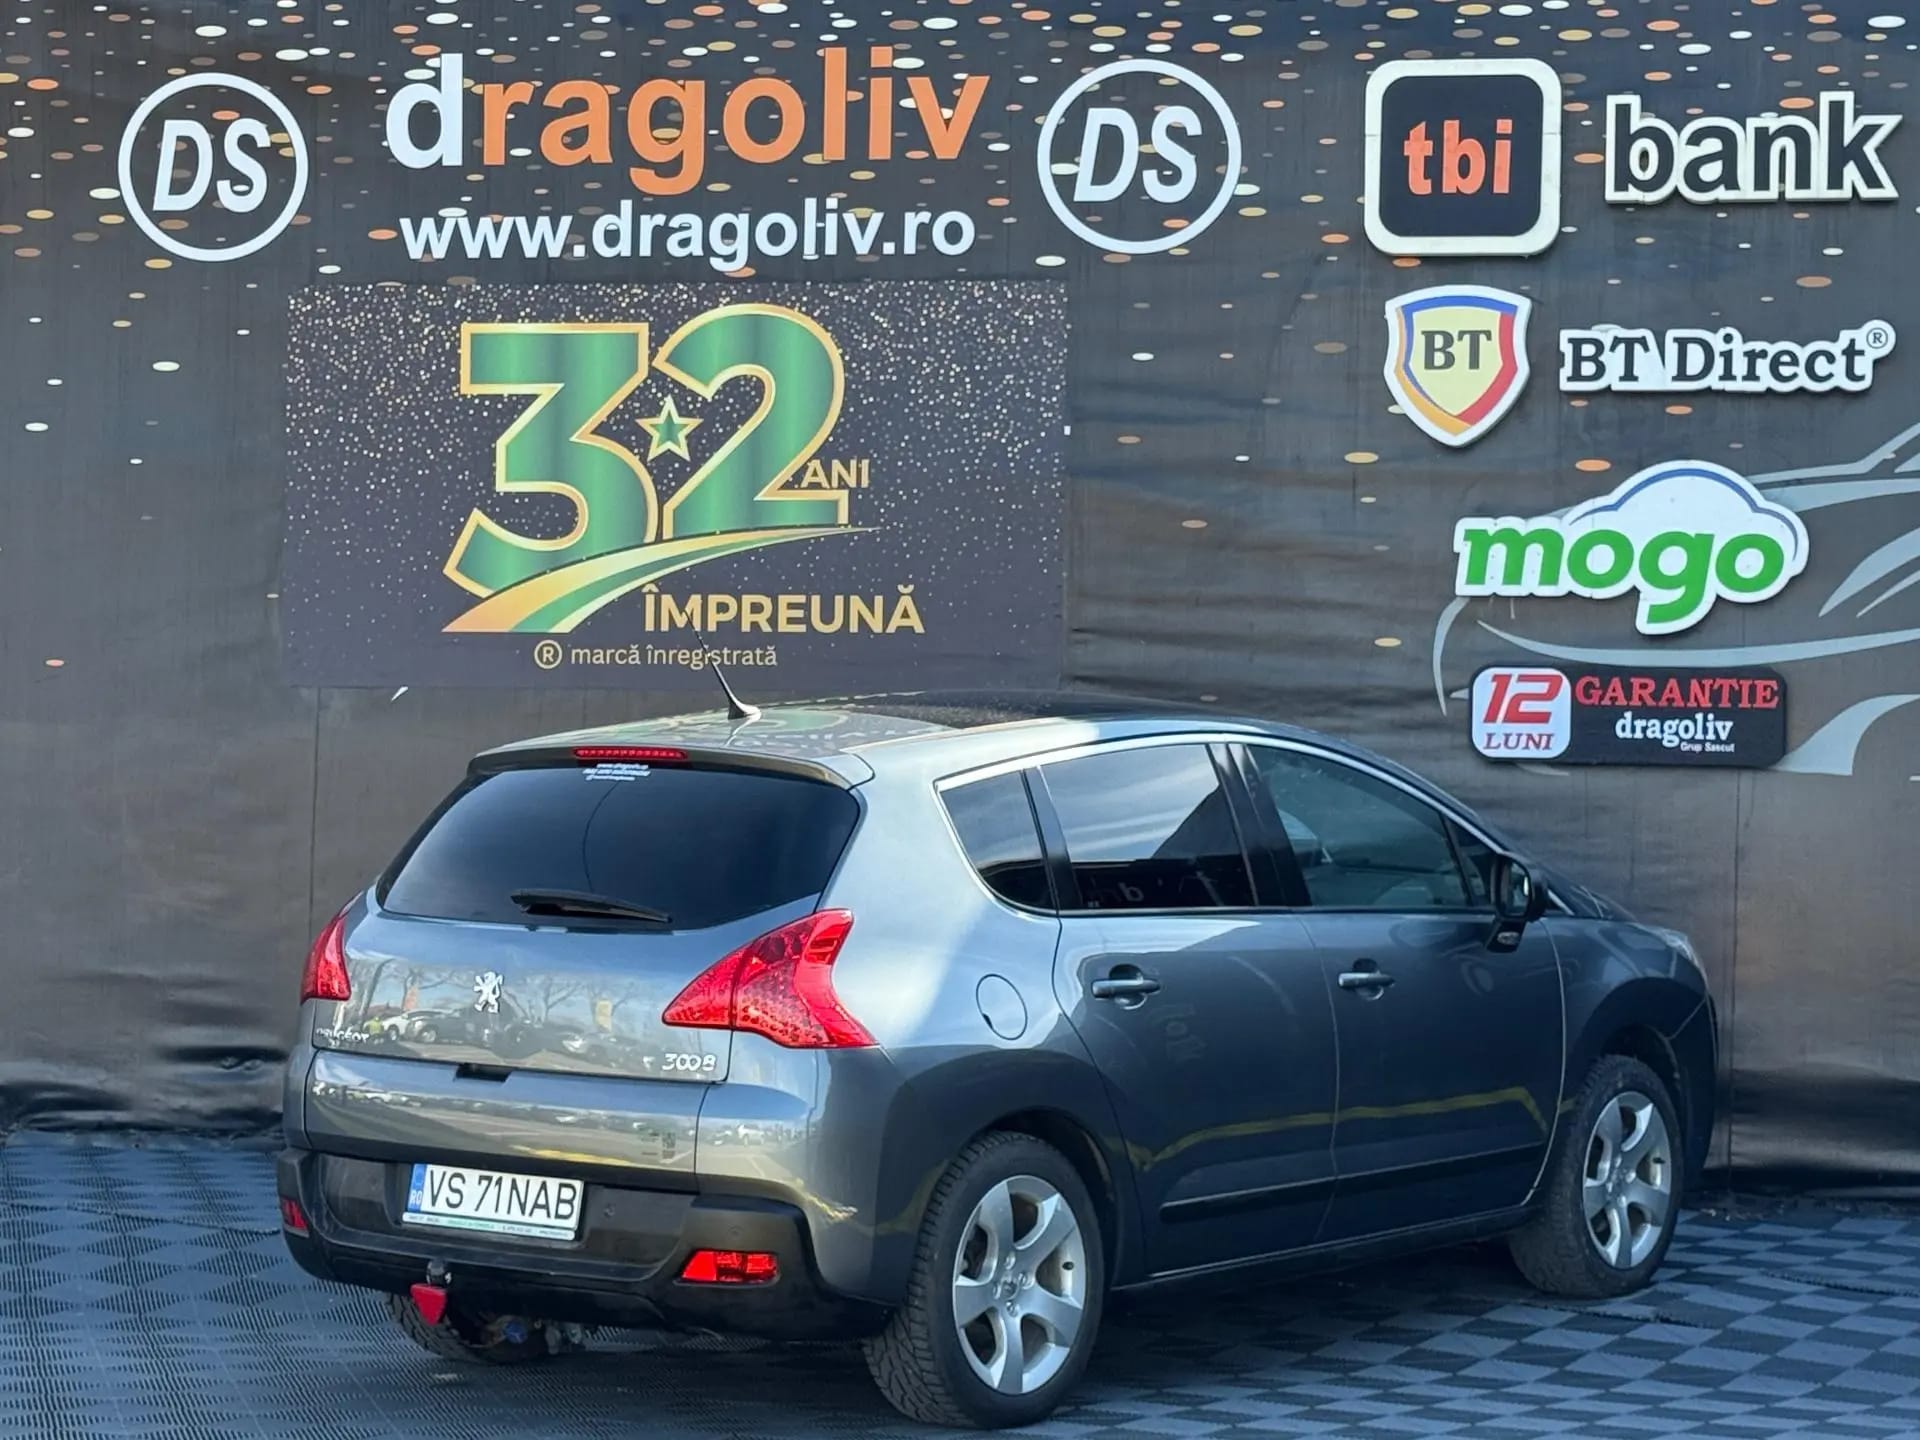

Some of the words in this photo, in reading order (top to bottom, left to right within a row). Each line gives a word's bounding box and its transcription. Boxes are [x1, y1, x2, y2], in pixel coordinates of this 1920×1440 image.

[386, 47, 990, 195] dragoliv
[1612, 96, 1897, 195] bank
[153, 118, 271, 213] DS
[1073, 105, 1202, 204] DS
[1404, 119, 1512, 195] tbi
[399, 198, 975, 272] www.dragoliv.ro
[1421, 329, 1492, 370] BT
[1566, 335, 1650, 382] BT
[442, 303, 845, 599] 32
[800, 460, 869, 488] ANI
[1463, 527, 1785, 624] mogo
[642, 584, 925, 633] ÎMPREUNĂ
[571, 643, 641, 666] marcă
[1482, 673, 1563, 724] 12
[1575, 676, 1779, 709] GARANTIE
[1482, 732, 1555, 751] LUNI
[1615, 712, 1733, 748] dragoliv
[661, 1053, 716, 1071] 3008
[429, 1169, 466, 1209] VS
